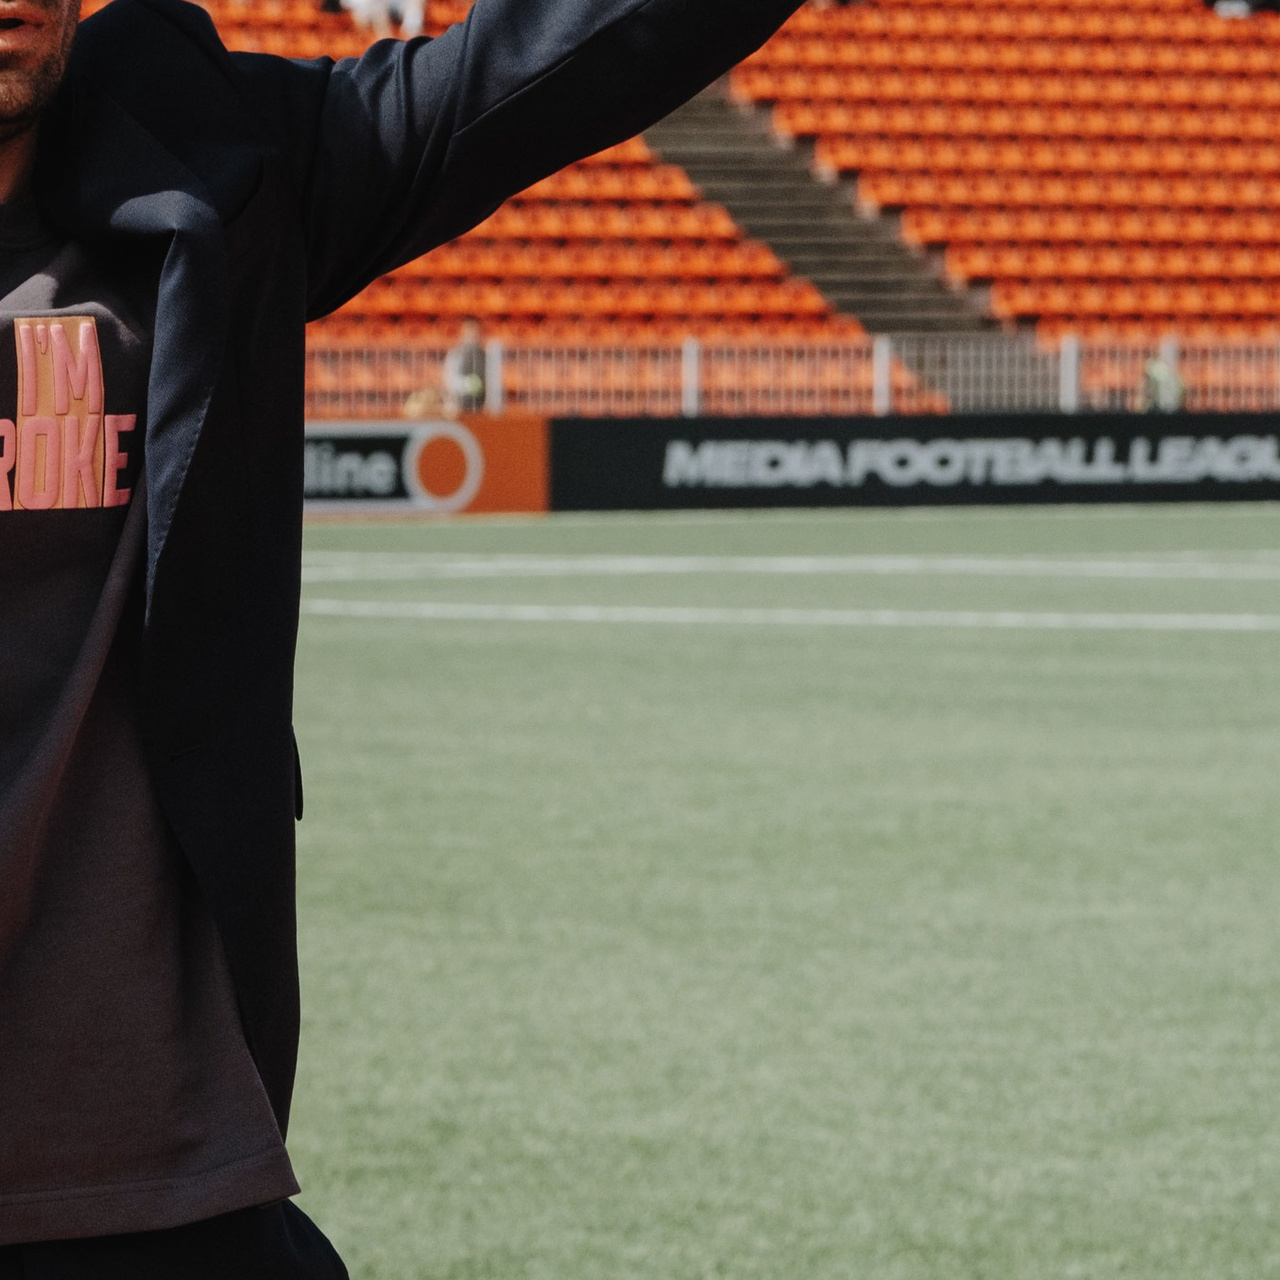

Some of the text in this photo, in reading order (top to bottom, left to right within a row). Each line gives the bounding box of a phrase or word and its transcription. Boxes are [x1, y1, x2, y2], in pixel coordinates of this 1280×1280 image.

[19, 322, 101, 416] I'M
[662, 439, 845, 488] MEDIA
[846, 437, 1121, 487] FOOTBALL
